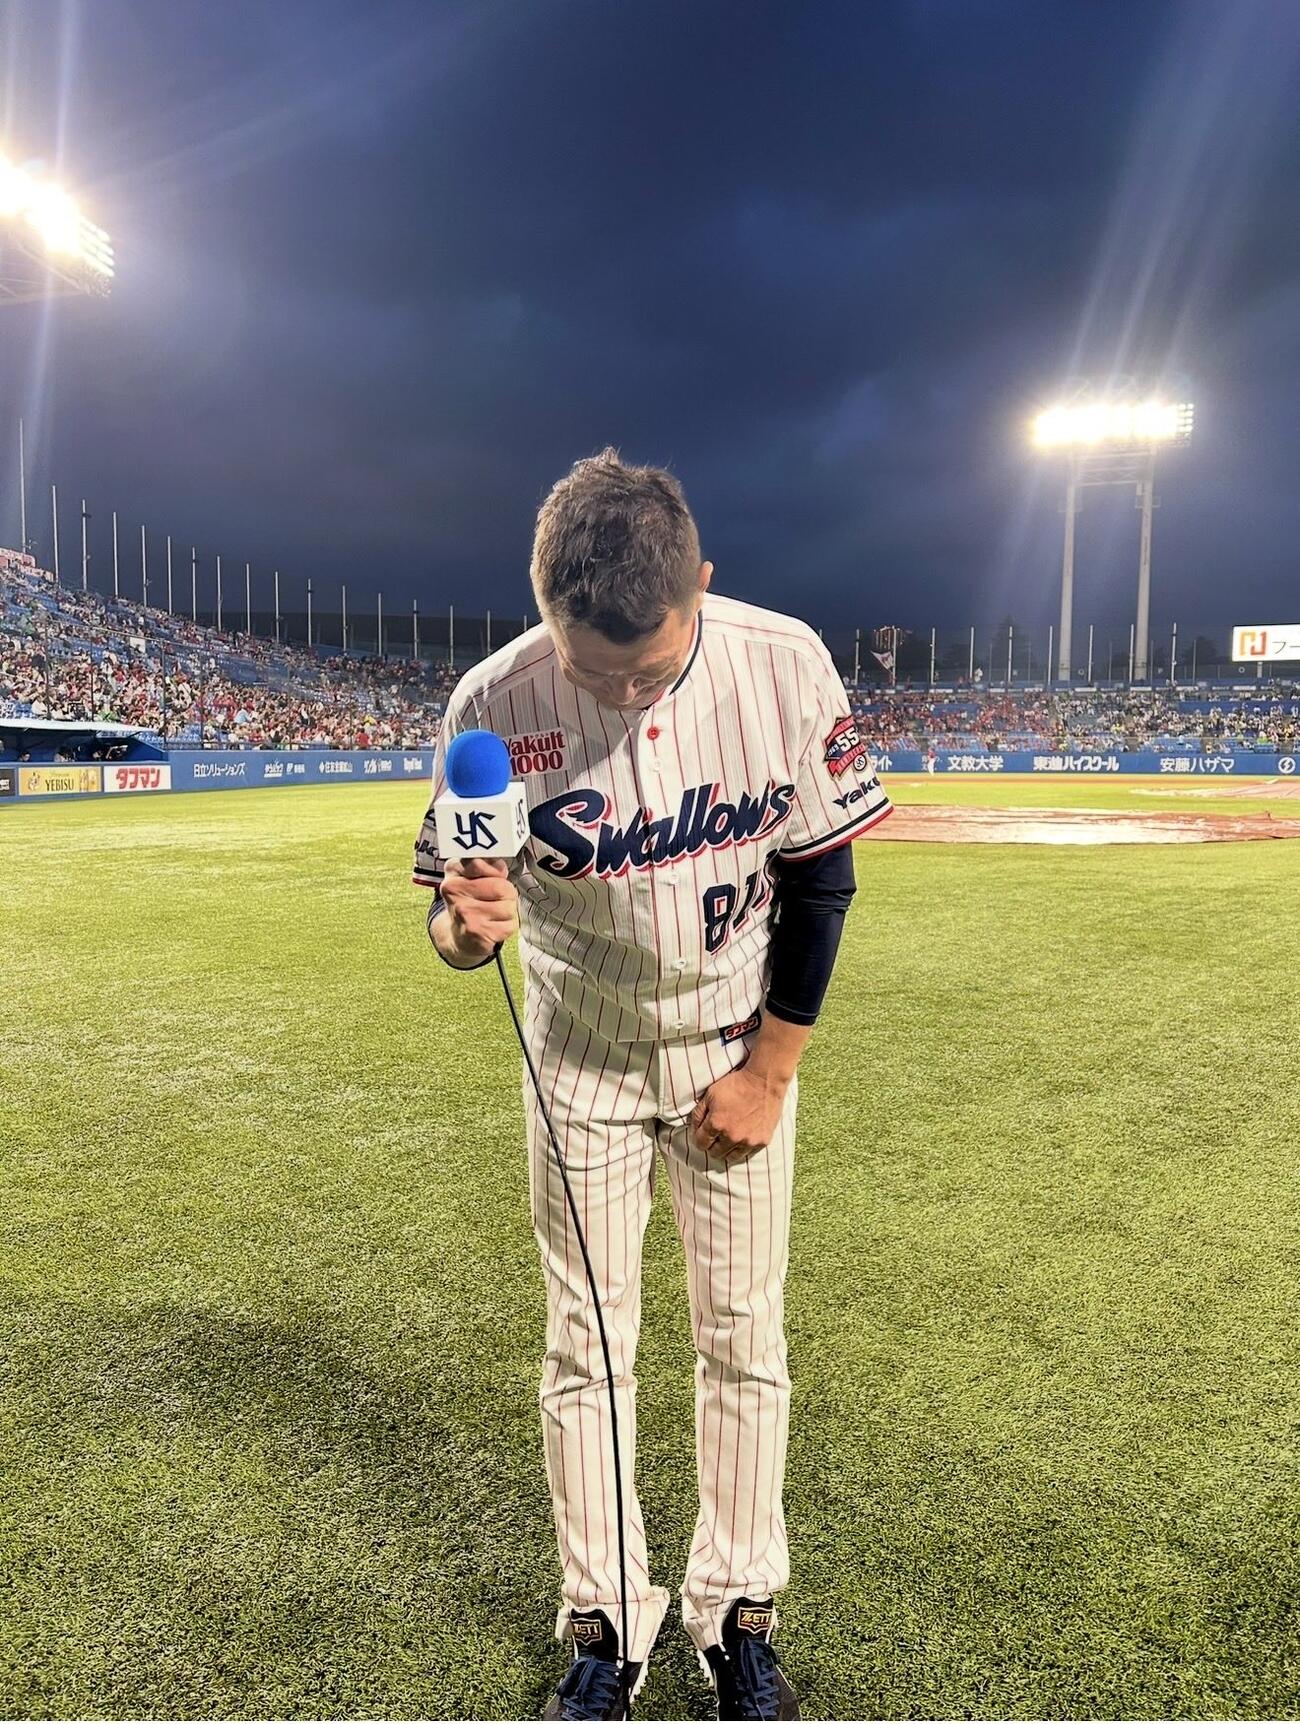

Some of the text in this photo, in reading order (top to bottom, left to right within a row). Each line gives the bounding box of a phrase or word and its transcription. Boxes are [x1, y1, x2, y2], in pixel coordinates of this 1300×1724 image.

[502, 731, 566, 757] Yakult
[834, 726, 860, 752] 55
[193, 762, 246, 778] 日立ソリューションズ
[510, 750, 563, 775] 1000
[947, 755, 1004, 772] 文教大学
[1033, 755, 1119, 772] 東進ハイスクール
[1160, 757, 1235, 773] 安藤ハザマ
[45, 778, 74, 791] YEBISU
[116, 768, 161, 790] タフマン
[528, 779, 798, 880] Swallows
